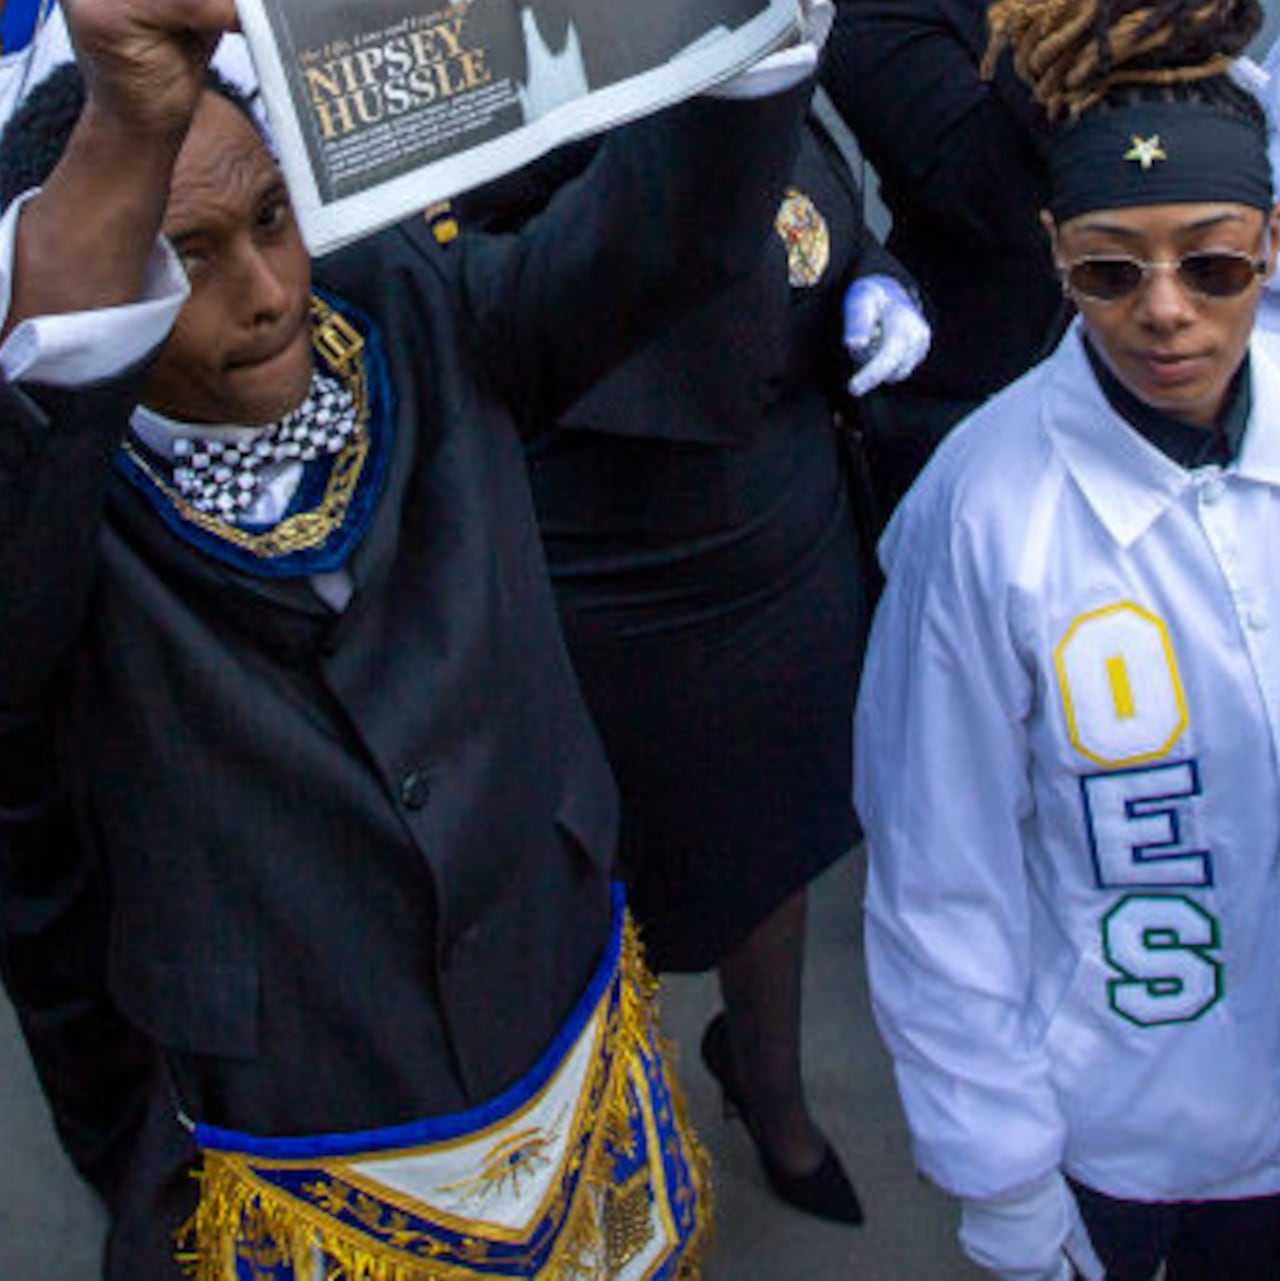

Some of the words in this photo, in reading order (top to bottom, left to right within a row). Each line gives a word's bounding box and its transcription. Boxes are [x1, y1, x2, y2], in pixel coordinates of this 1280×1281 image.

[304, 18, 464, 105] NIPSEY
[315, 48, 492, 140] HUSSLE
[1053, 600, 1224, 1029] OES
